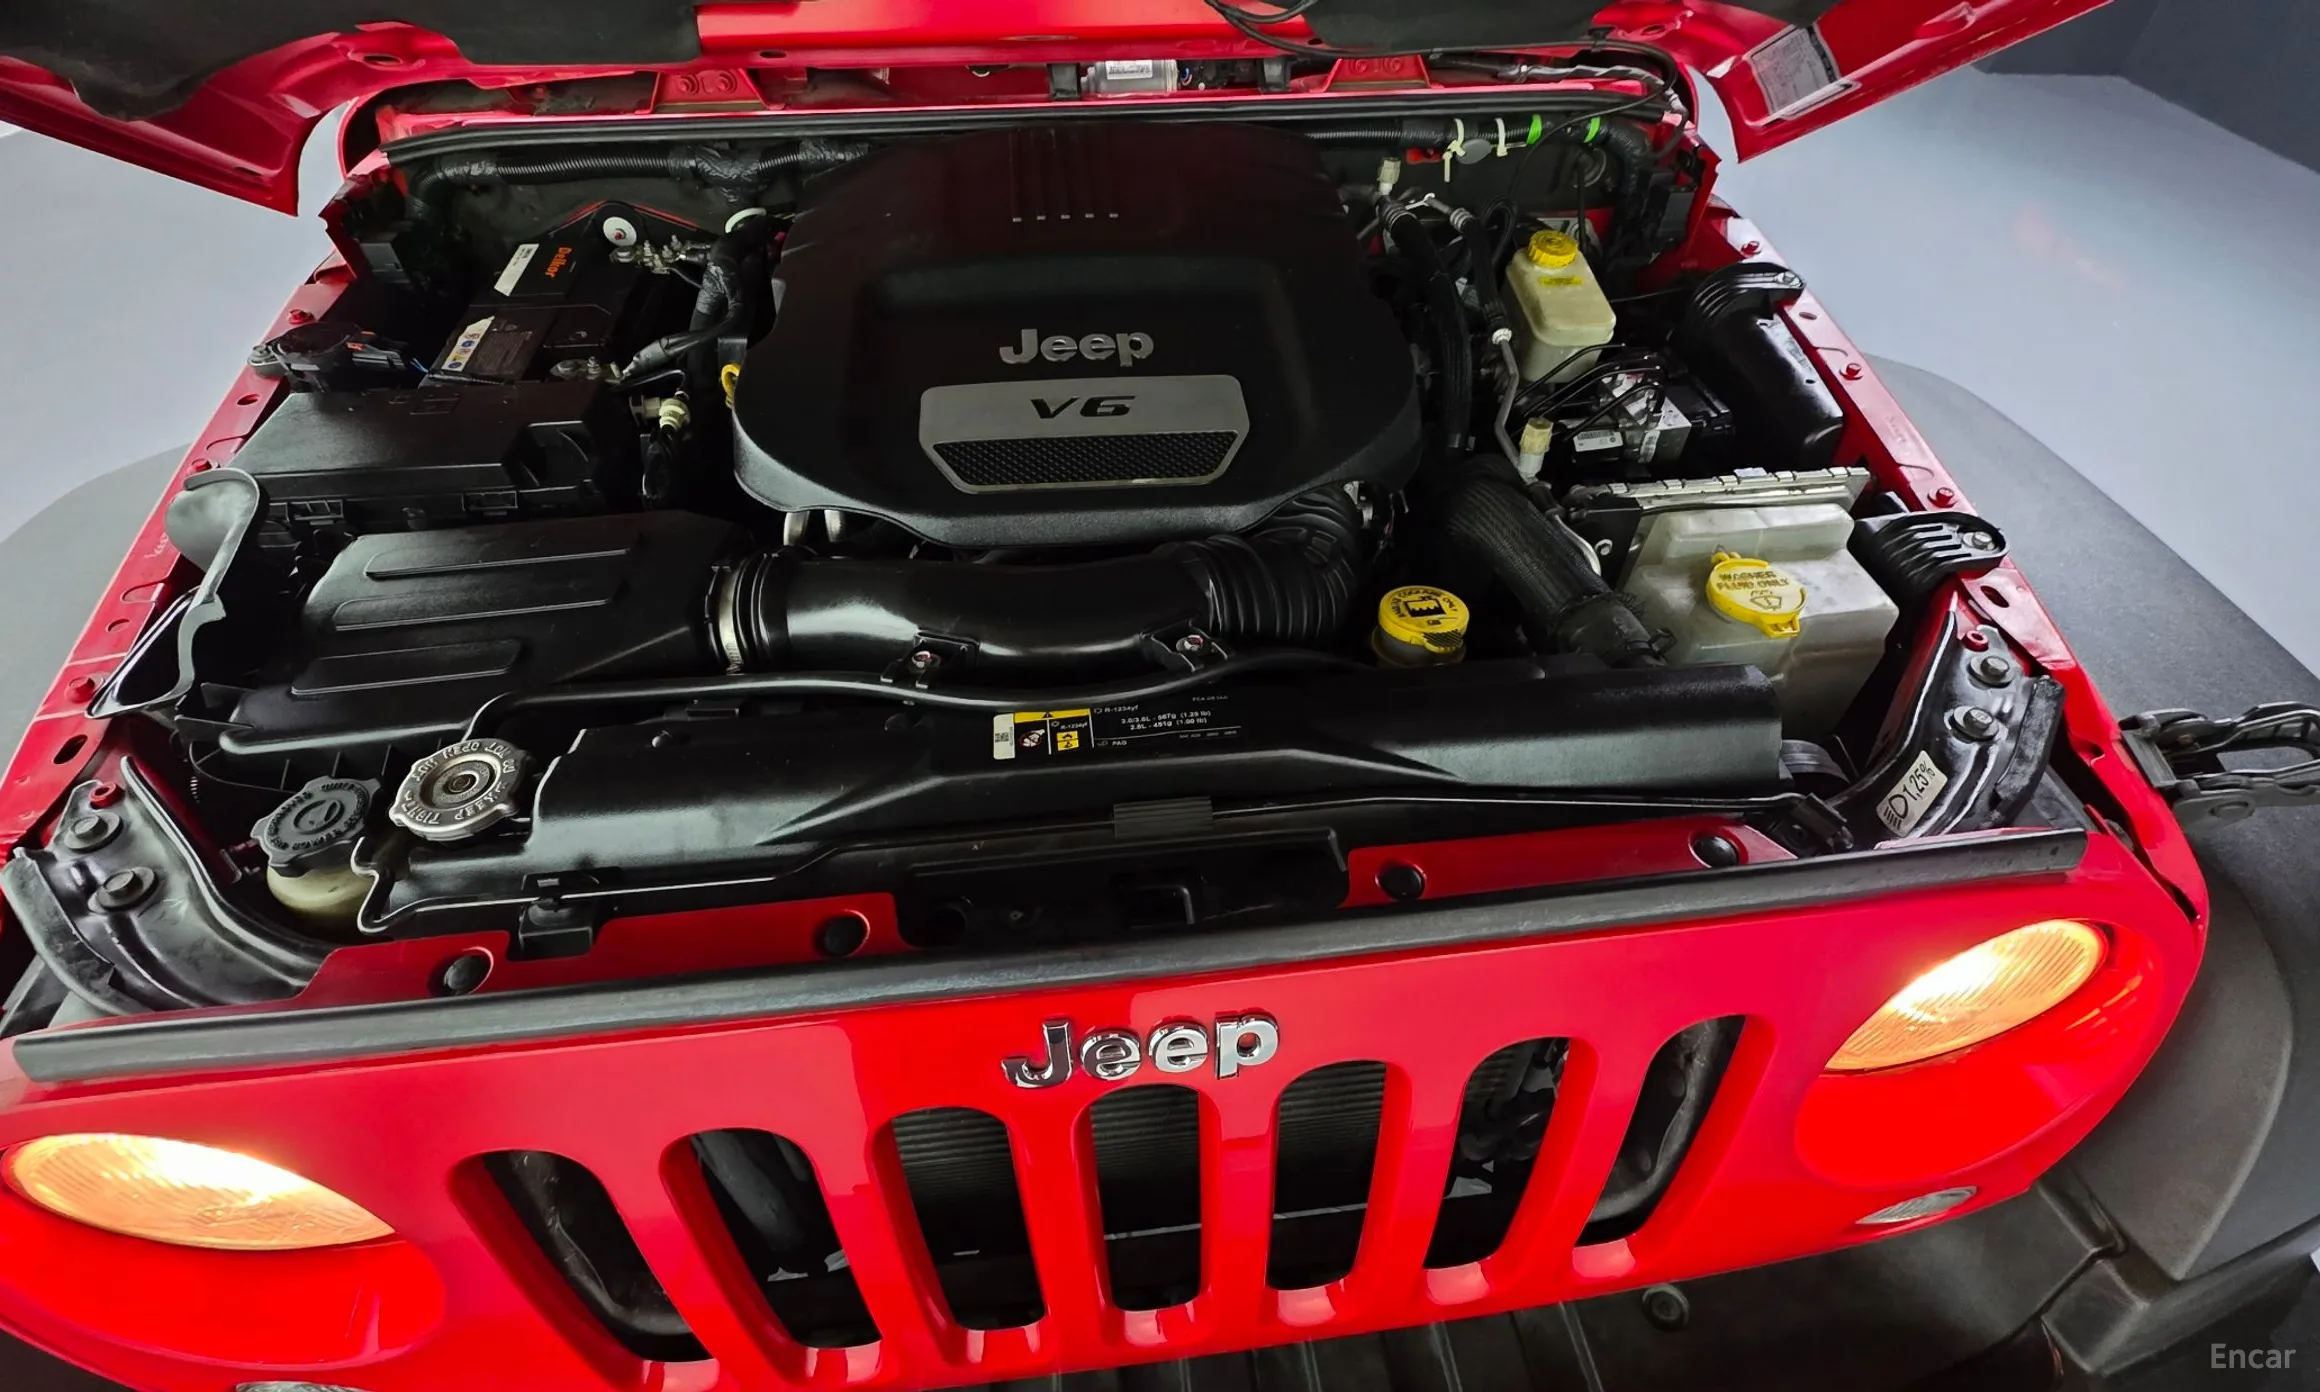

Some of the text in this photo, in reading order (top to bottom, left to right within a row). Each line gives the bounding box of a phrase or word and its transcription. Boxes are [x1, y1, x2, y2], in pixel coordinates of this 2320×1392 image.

[545, 247, 573, 278] Delkor
[999, 328, 1154, 367] Jeep
[1030, 395, 1136, 419] V6
[442, 741, 480, 760] OPEN
[1001, 1012, 1280, 1089] Jeep
